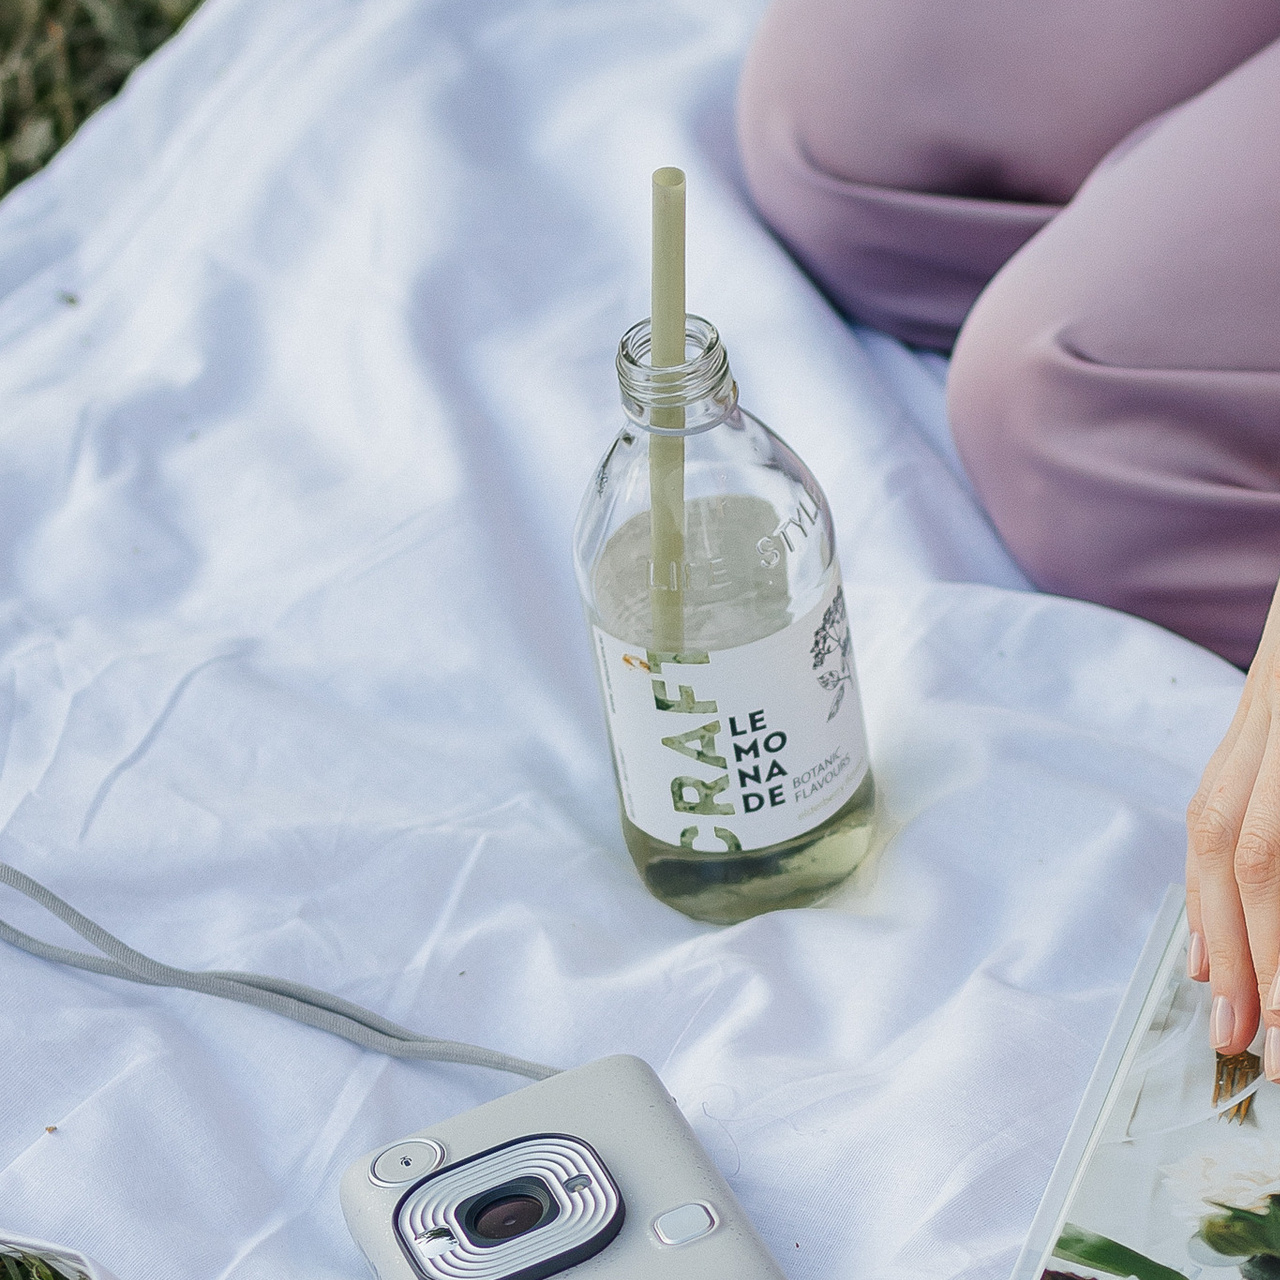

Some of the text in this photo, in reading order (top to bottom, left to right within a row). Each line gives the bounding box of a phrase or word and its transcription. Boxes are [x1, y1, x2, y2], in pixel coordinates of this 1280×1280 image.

[729, 709, 767, 736] LE
[646, 648, 743, 852] CRAFT
[733, 731, 787, 762] MO
[737, 759, 788, 787] NA
[795, 752, 850, 802] FLAVOURS
[742, 784, 786, 813] DE
